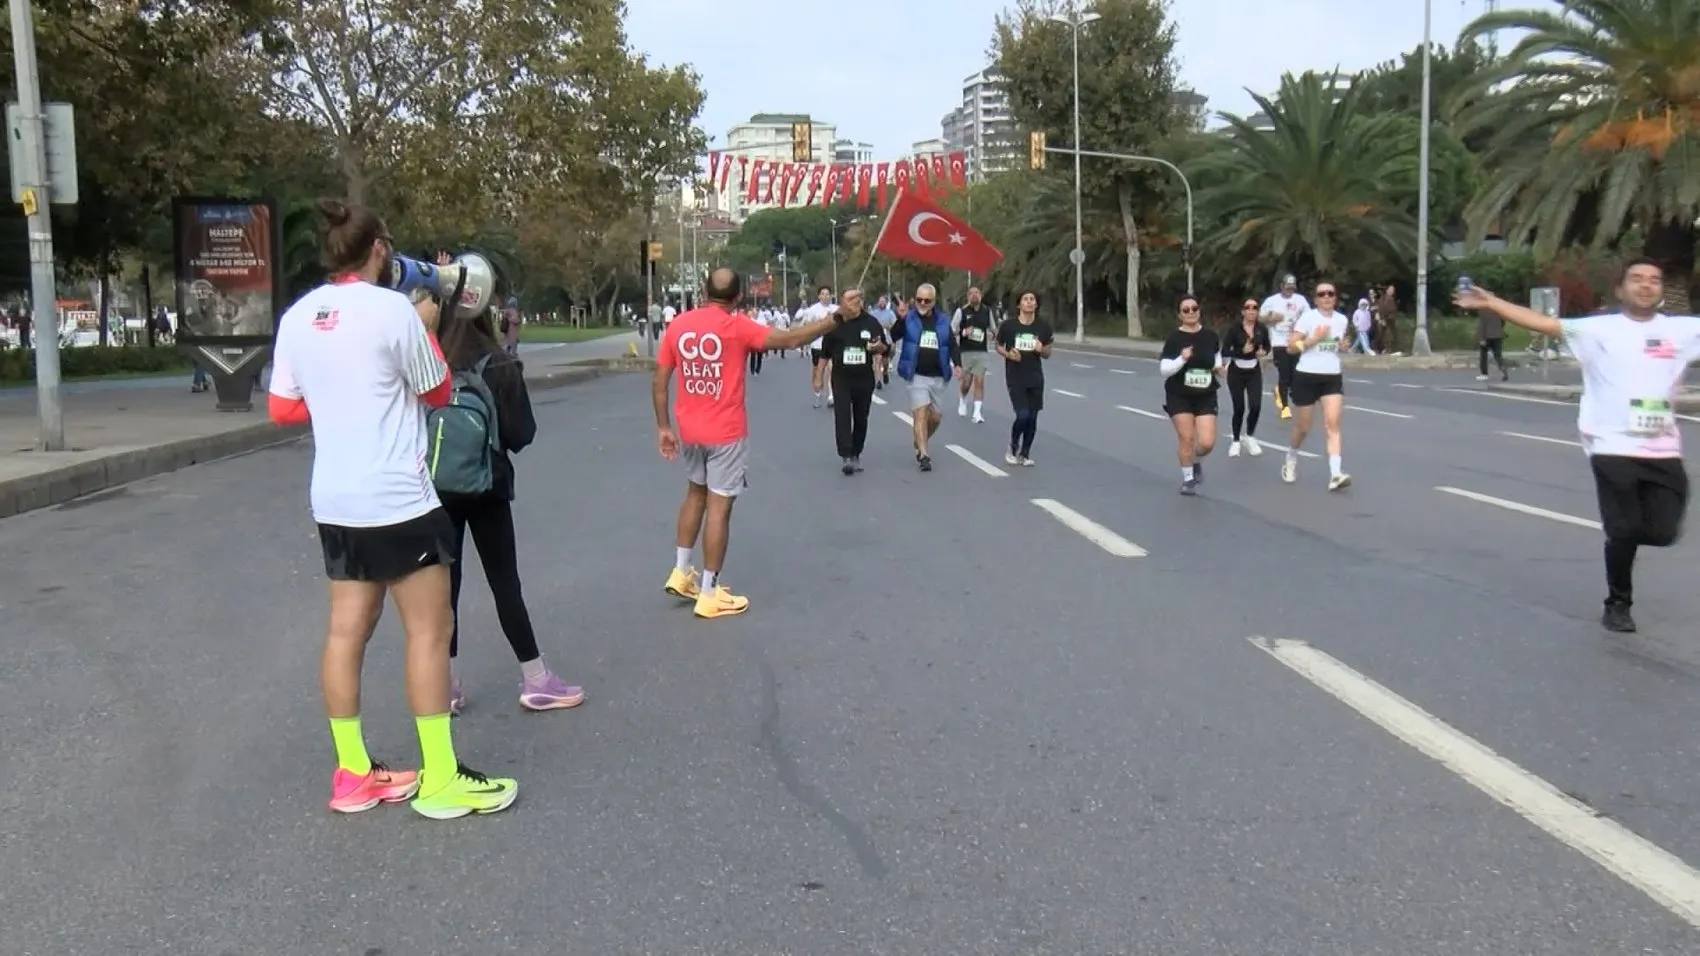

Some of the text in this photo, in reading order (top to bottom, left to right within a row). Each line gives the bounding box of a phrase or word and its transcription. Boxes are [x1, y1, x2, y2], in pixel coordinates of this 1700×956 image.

[209, 228, 244, 238] MALTEPE
[678, 331, 722, 361] GO
[682, 361, 723, 378] BEAT
